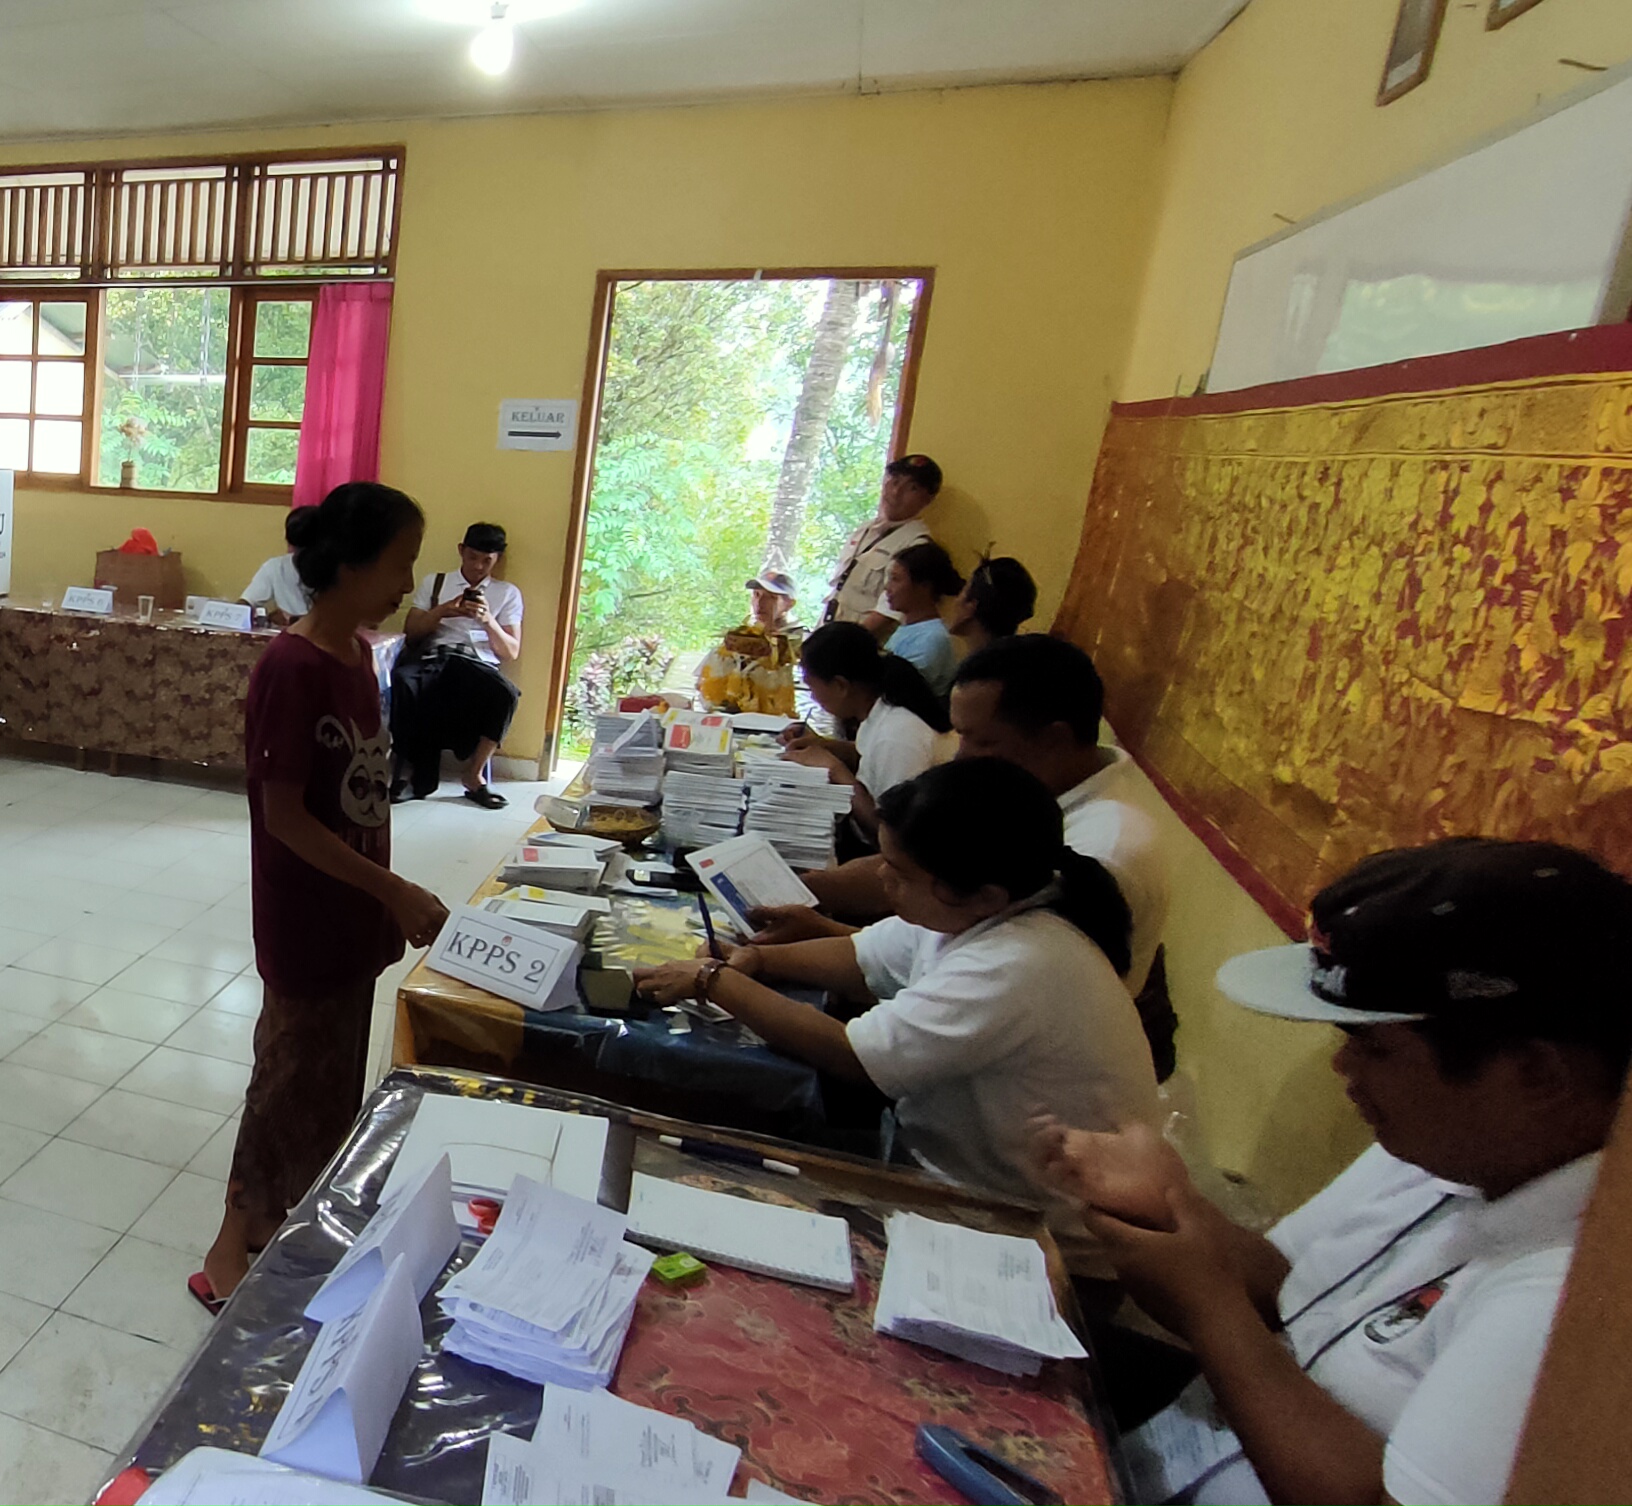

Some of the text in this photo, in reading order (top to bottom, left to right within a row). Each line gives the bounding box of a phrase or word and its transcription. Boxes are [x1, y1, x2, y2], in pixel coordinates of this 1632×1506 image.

[511, 411, 565, 423] KELUAR
[206, 609, 233, 621] KPPS
[448, 931, 545, 983] KPPS 2
